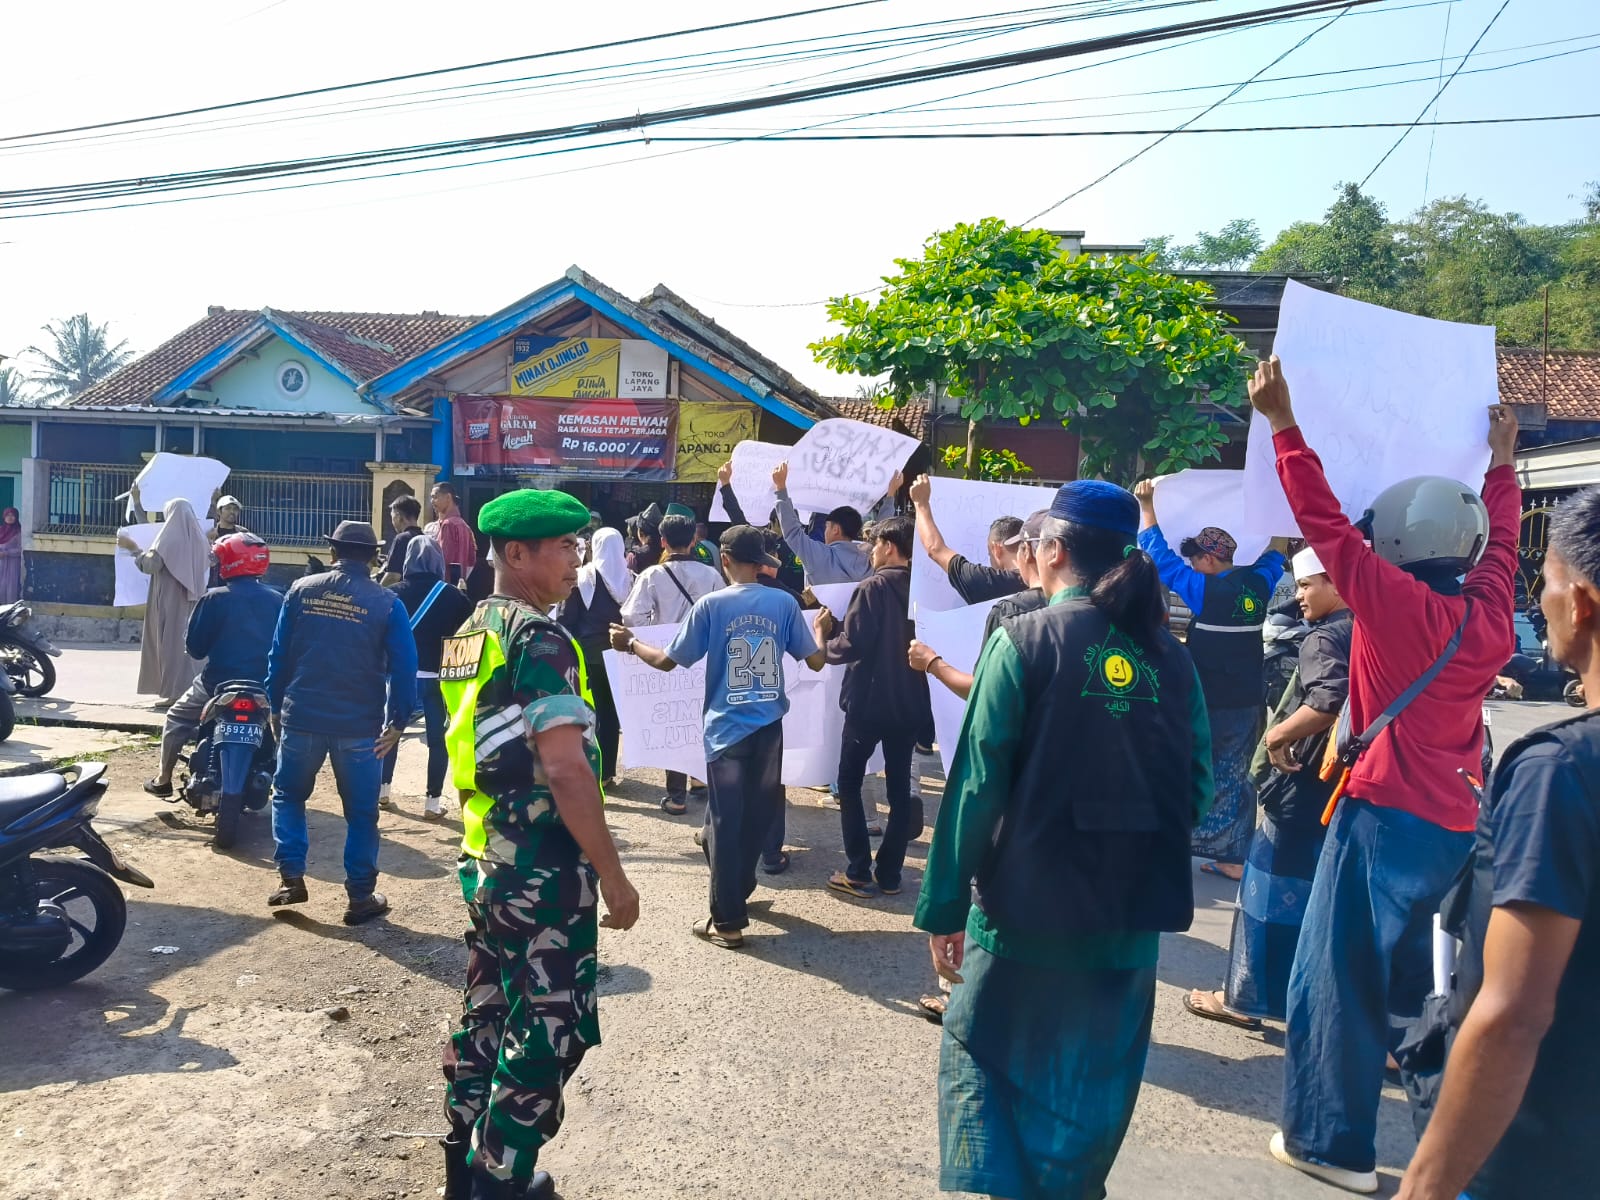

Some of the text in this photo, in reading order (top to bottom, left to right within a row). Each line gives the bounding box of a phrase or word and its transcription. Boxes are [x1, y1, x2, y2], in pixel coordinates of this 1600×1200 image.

[515, 341, 590, 388] MINAK DJINGGO
[501, 419, 537, 430] GARAM
[558, 415, 669, 427] KEMASAN MEWAH
[581, 426, 602, 434] KHAS
[631, 427, 667, 435] TERJAGA
[503, 430, 533, 449] Merah
[562, 437, 580, 450] Rp
[678, 444, 720, 454] APANG
[727, 637, 779, 690] 24
[220, 724, 245, 734] 5692
